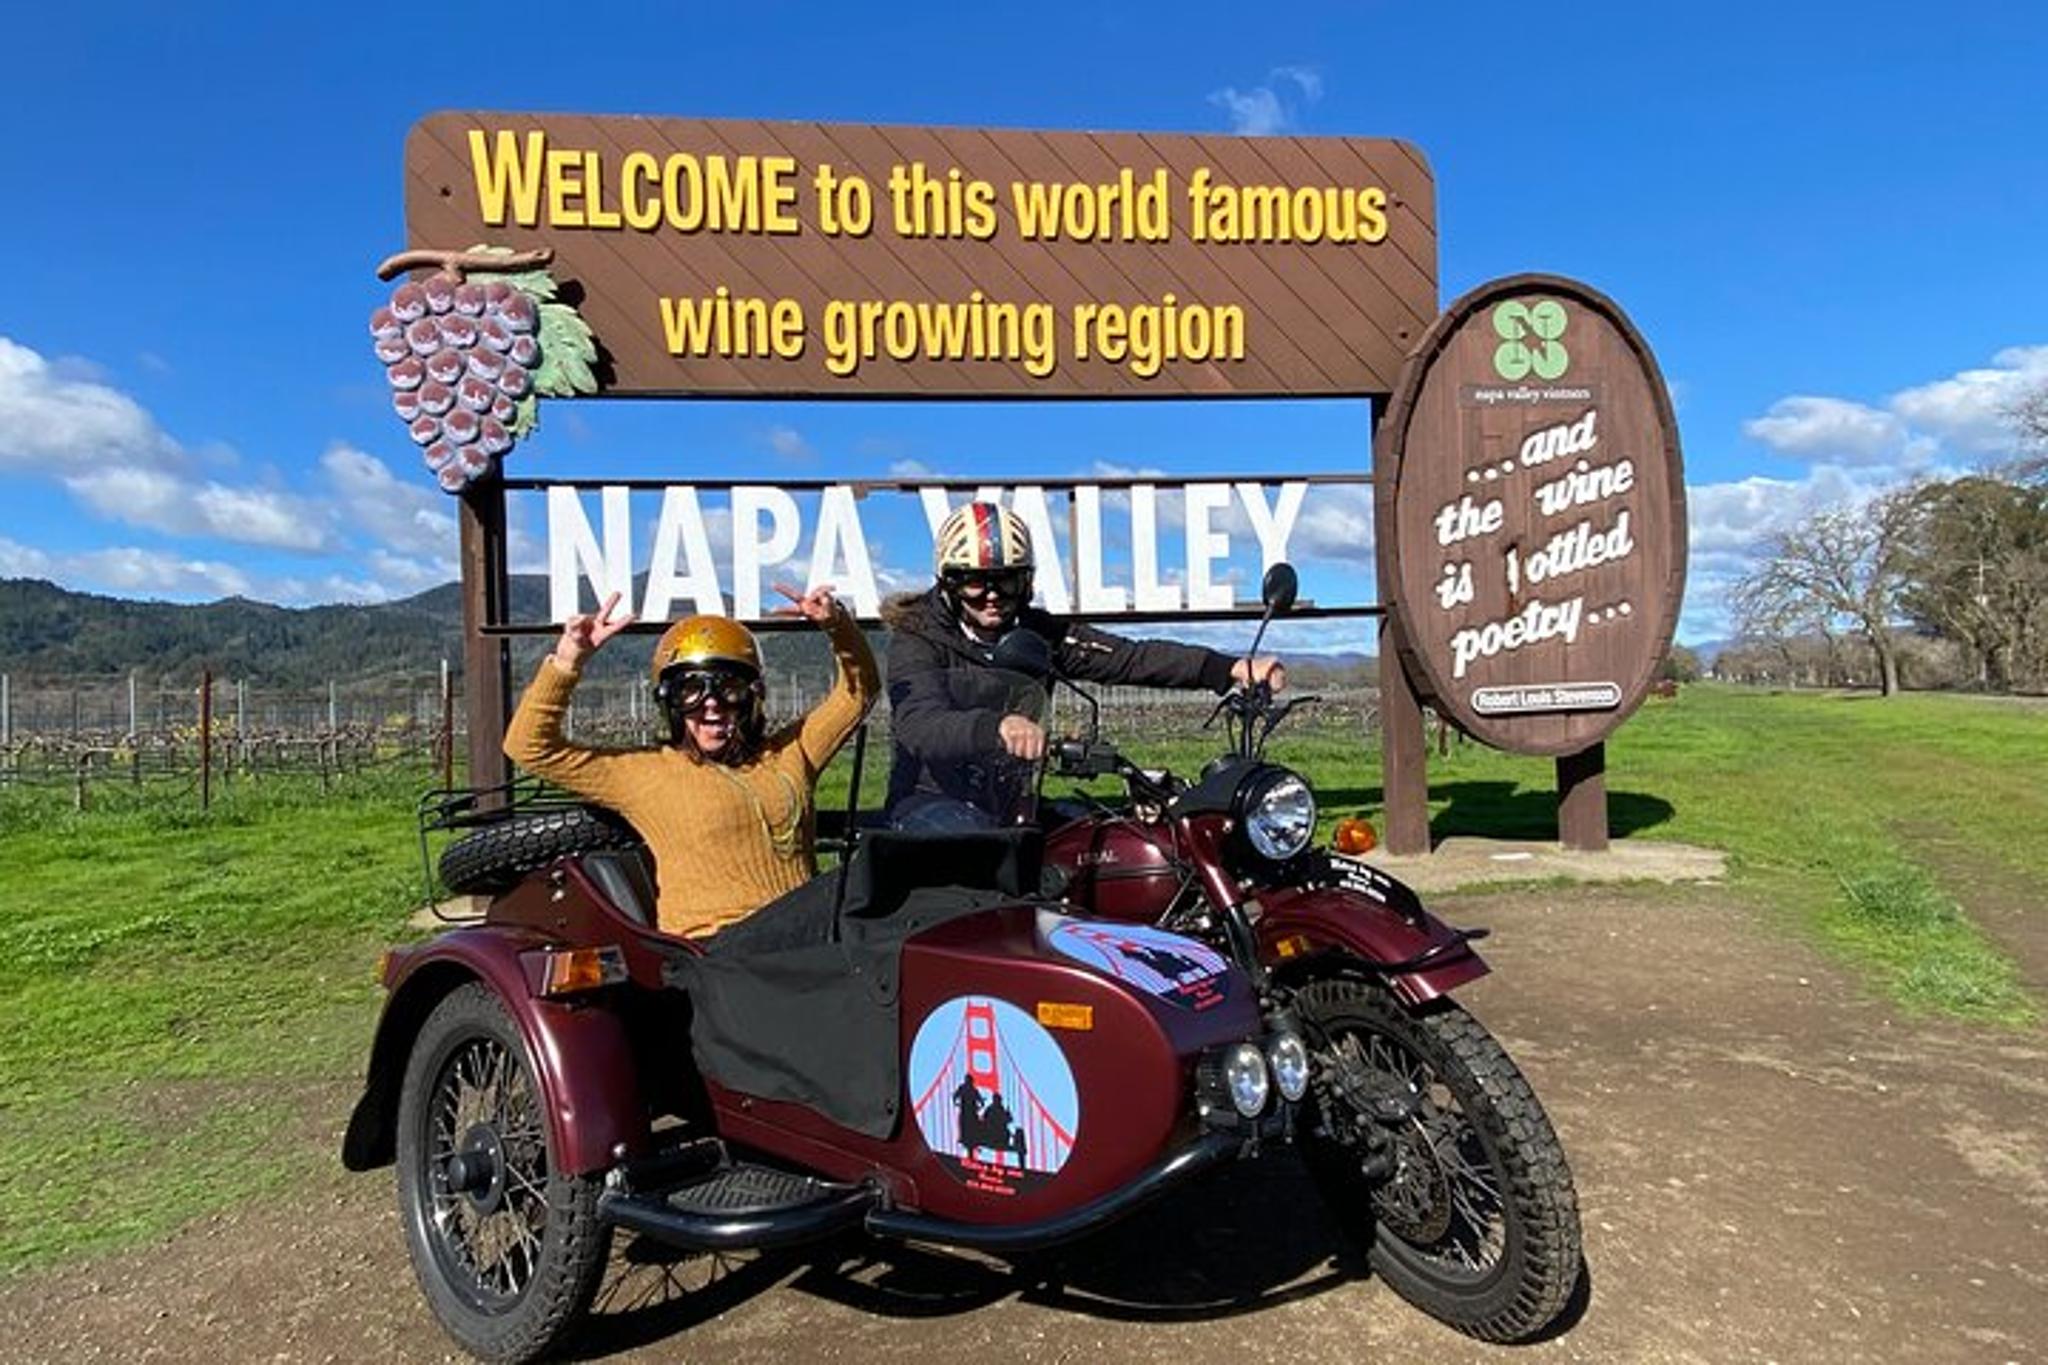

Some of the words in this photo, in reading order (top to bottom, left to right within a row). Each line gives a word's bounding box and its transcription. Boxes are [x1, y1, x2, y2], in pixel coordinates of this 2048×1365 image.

[468, 129, 799, 232] WELCOME
[813, 164, 872, 235] to
[888, 162, 997, 238] this
[1011, 167, 1170, 241] world
[1187, 167, 1389, 243] famous
[659, 286, 804, 357] wine
[822, 290, 1055, 376] growing
[1074, 293, 1245, 377] region
[1434, 496, 1504, 546] the
[1535, 459, 1635, 517] wine
[547, 485, 882, 623] NAPA
[1436, 562, 1475, 610] is
